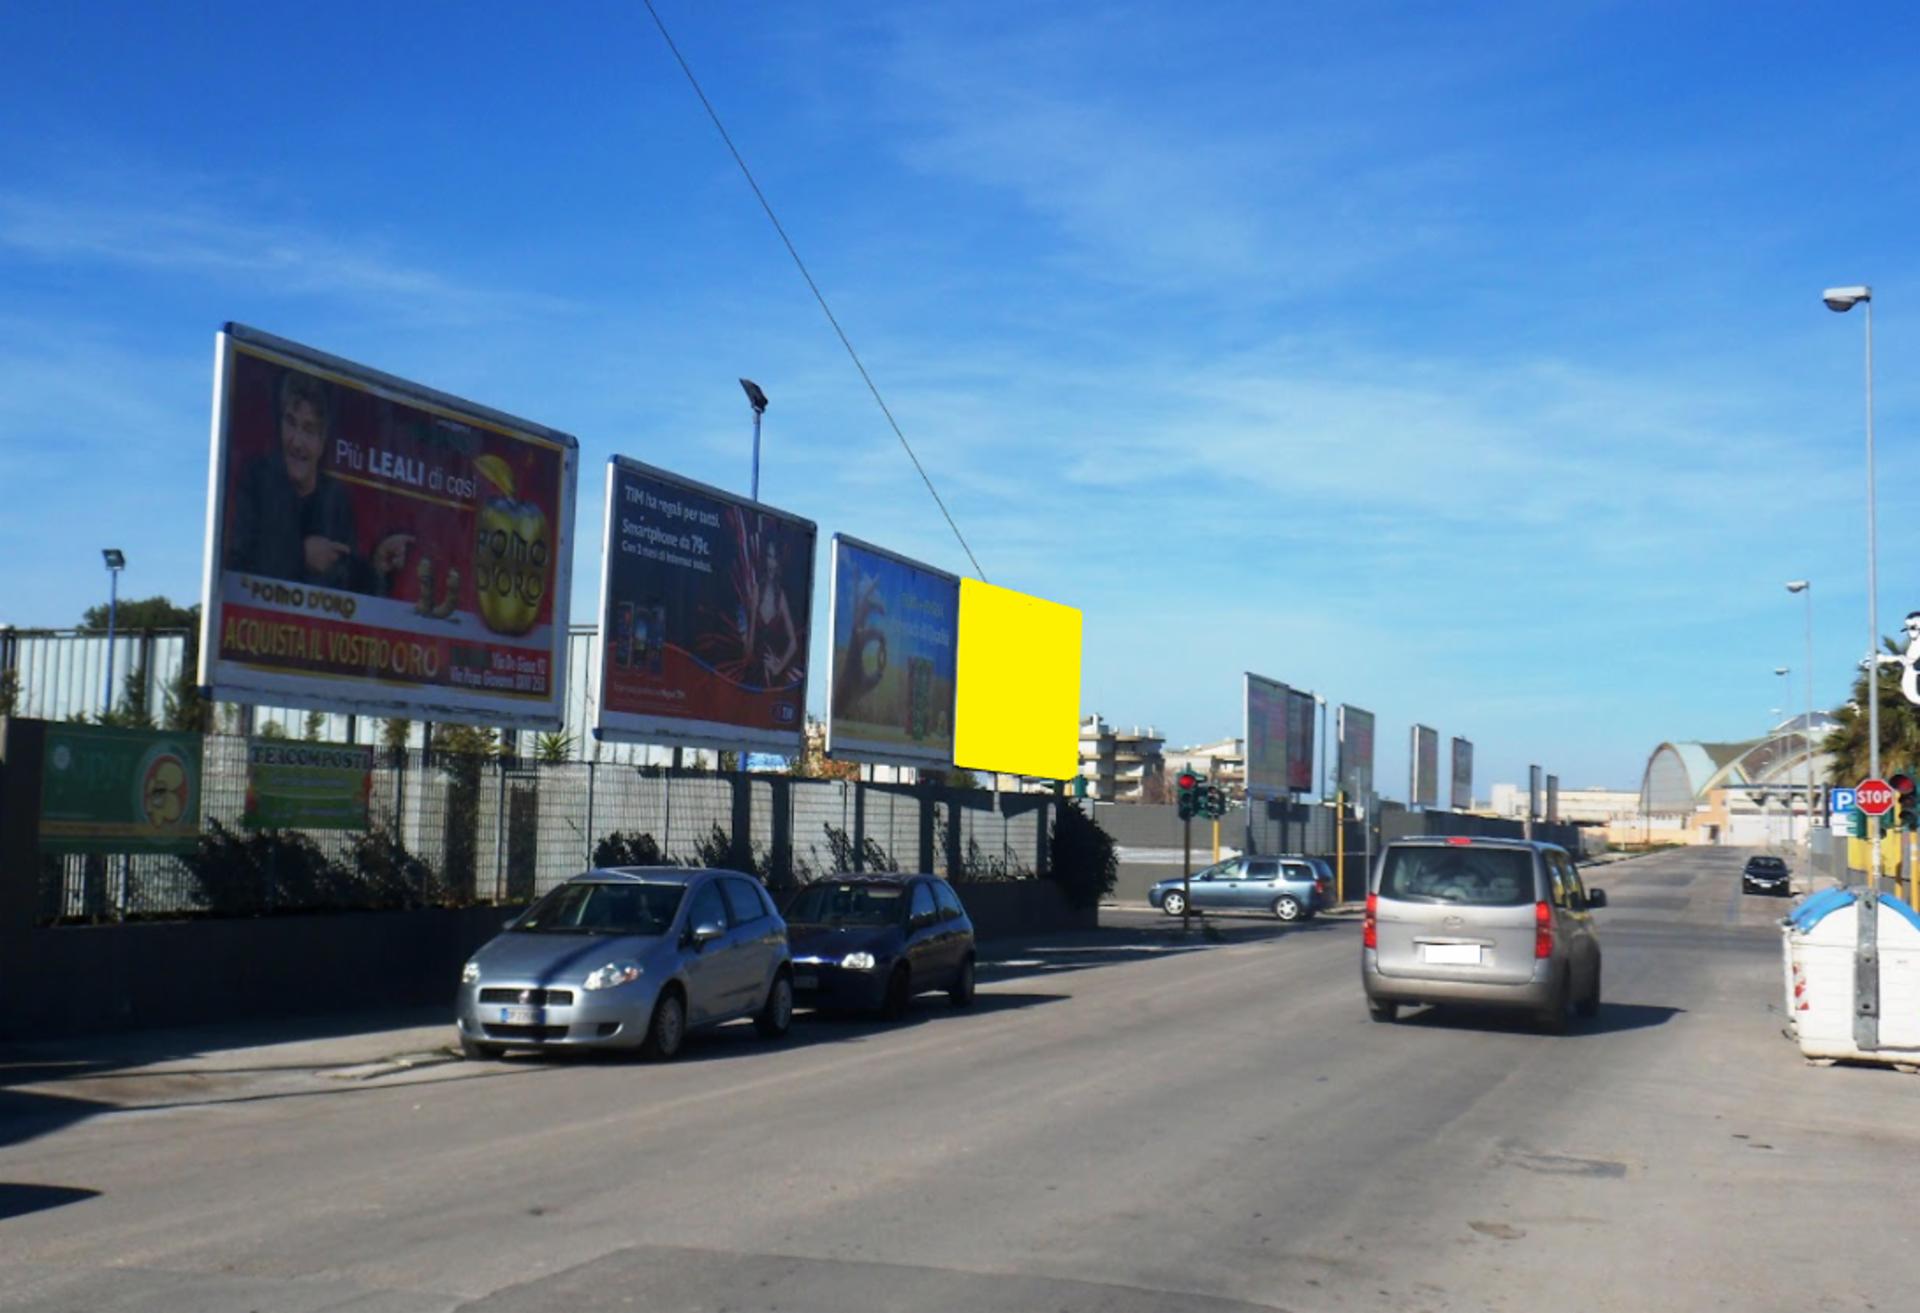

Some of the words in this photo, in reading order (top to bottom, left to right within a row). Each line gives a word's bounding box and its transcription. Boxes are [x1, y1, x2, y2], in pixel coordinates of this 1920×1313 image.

[335, 439, 363, 470] Più
[368, 447, 425, 486] LEALI
[428, 466, 443, 490] di
[624, 484, 645, 505] TIM
[646, 492, 657, 509] ha
[658, 499, 682, 519] regali
[683, 506, 698, 522] per
[622, 518, 678, 547] Smartphone
[679, 534, 691, 550] da
[224, 616, 306, 659] ACQUISTA
[310, 628, 323, 661] IL
[328, 631, 391, 670] VOSTRO
[391, 640, 440, 678] ORO
[1836, 791, 1853, 811] P
[1857, 790, 1891, 804] STOP
